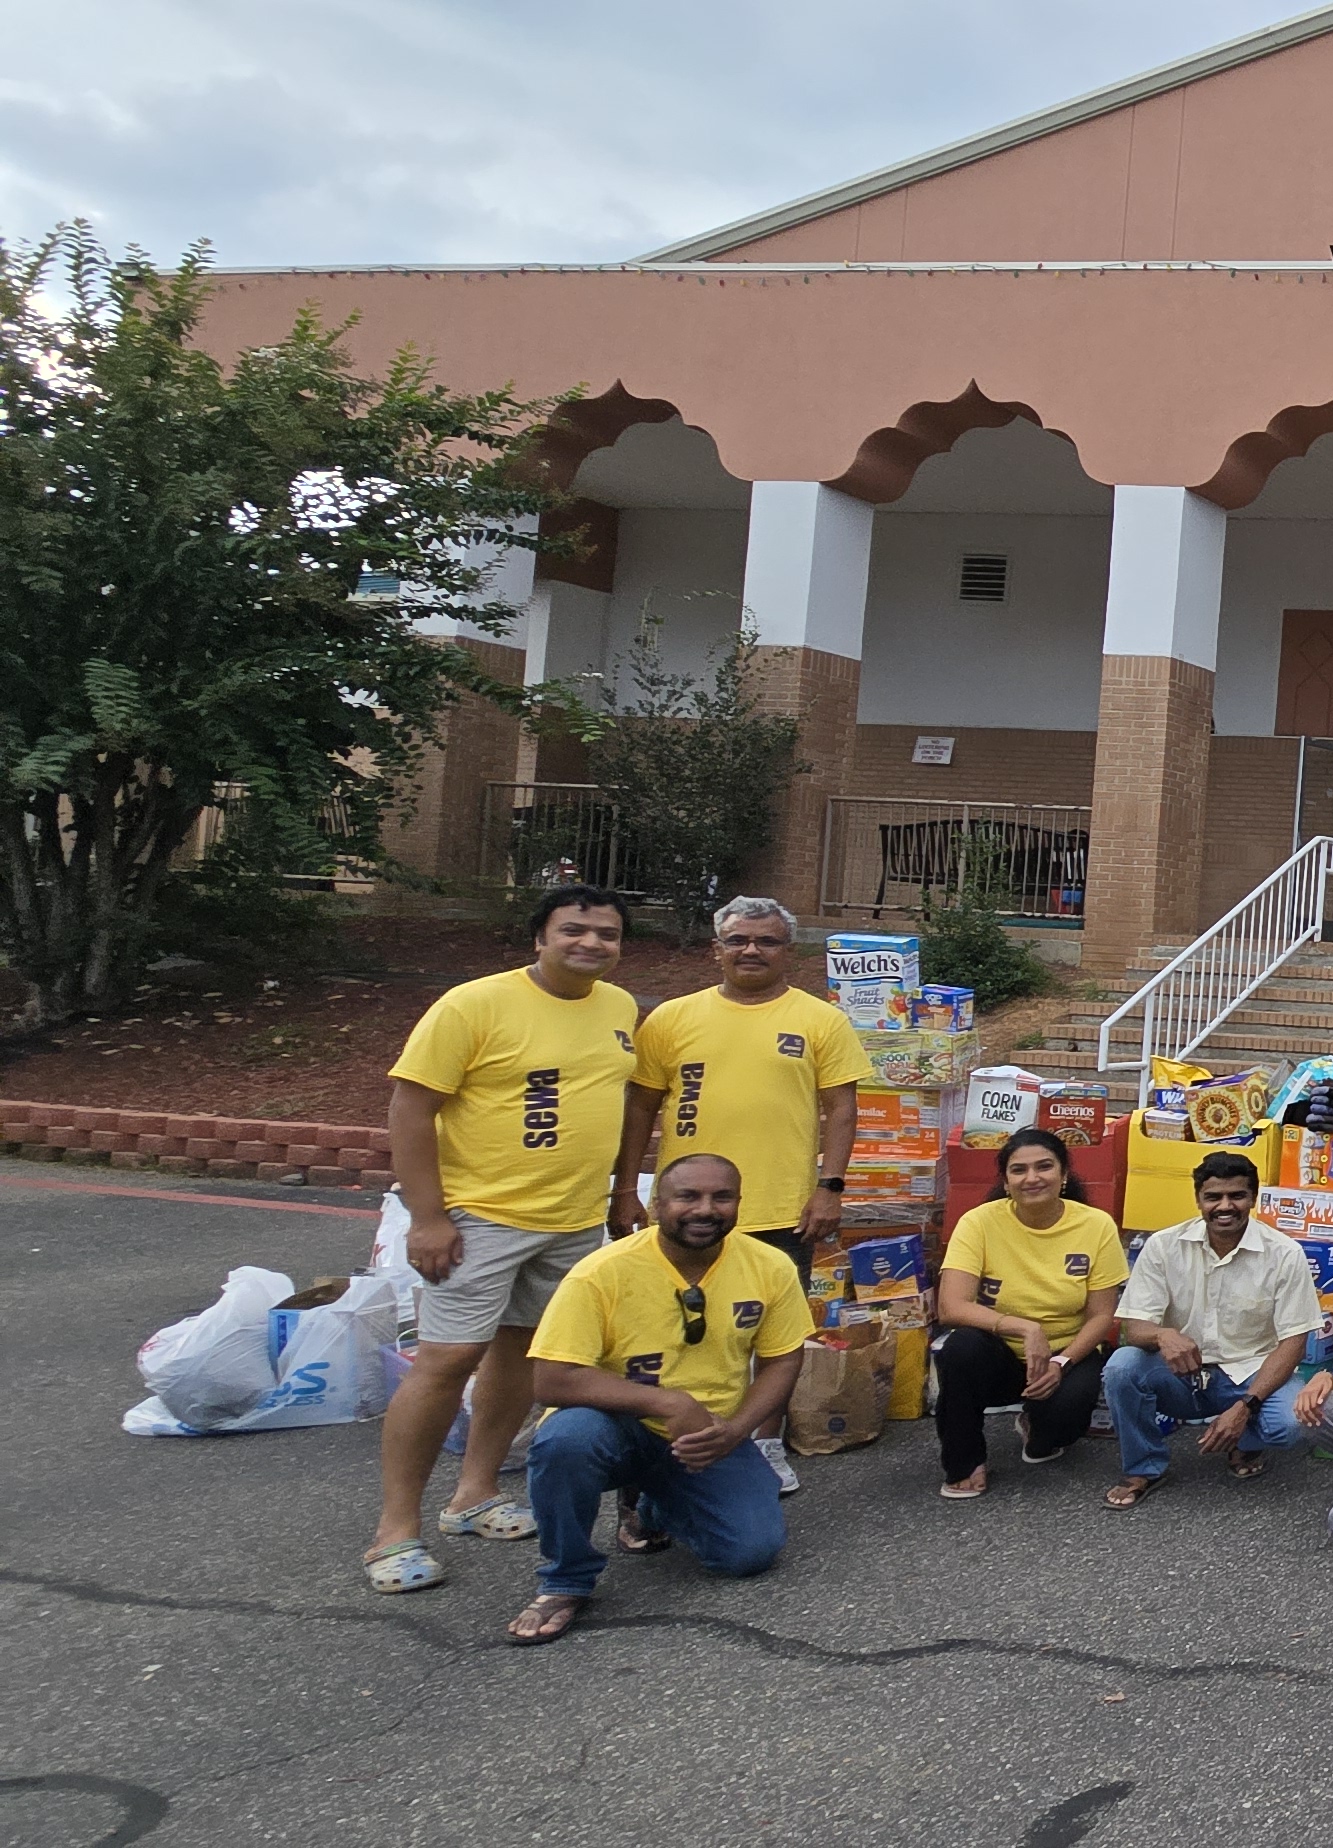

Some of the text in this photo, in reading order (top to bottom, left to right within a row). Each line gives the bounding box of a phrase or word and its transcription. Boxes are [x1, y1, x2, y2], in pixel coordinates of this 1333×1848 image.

[831, 955, 900, 975] Welch's
[847, 995, 885, 1007] Snacks
[853, 988, 880, 998] Fruit
[523, 1067, 560, 1149] sewa
[676, 1061, 706, 1137] sewa
[981, 1090, 1023, 1112] CORN
[981, 1107, 1016, 1123] FLAKES
[1049, 1103, 1095, 1117] Cheerios
